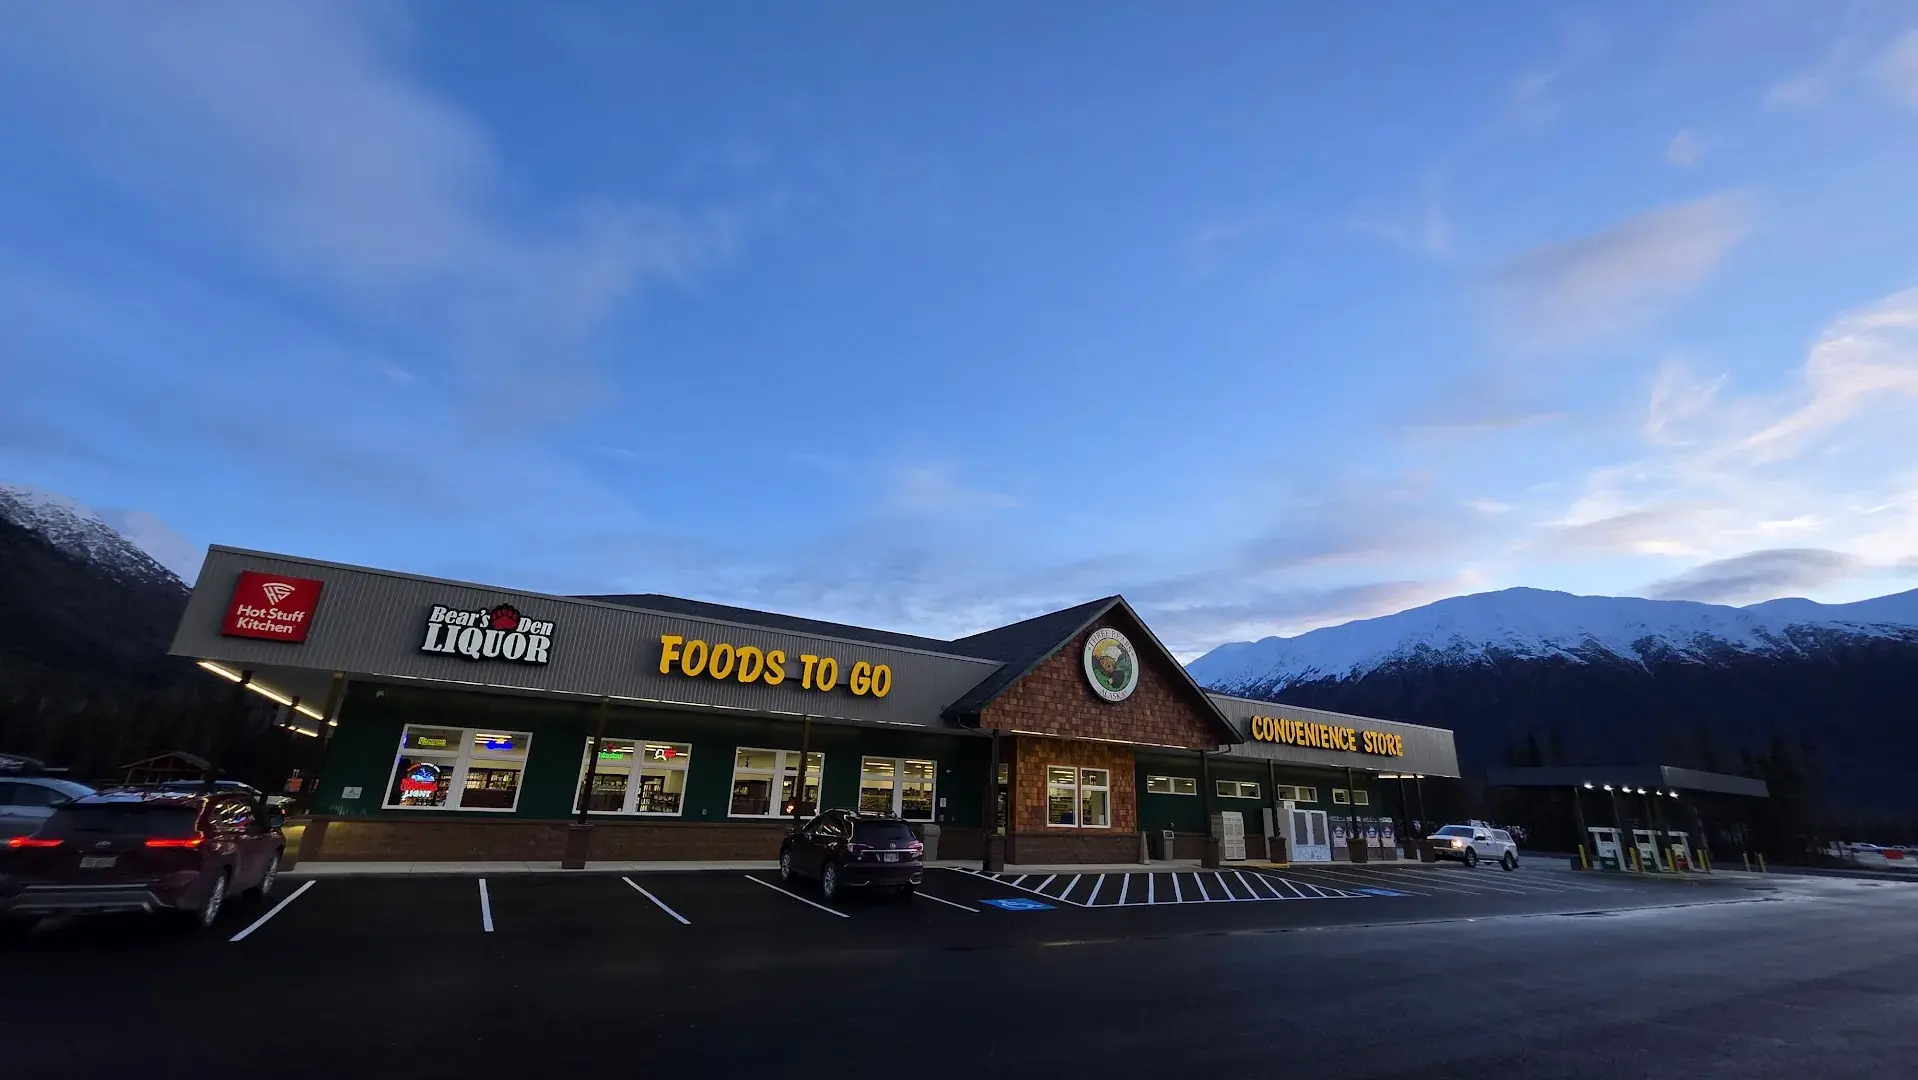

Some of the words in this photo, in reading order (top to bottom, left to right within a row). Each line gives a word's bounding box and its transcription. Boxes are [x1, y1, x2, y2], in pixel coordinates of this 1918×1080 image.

[236, 617, 294, 634] Kitchen
[237, 604, 267, 618] Hot
[267, 608, 305, 623] Stuff
[430, 606, 491, 628] Bear's
[517, 617, 554, 636] Den
[422, 623, 551, 663] LIQUOR
[1088, 630, 1110, 647] THREE
[1111, 630, 1132, 653] BEARS
[659, 635, 786, 686] FOODS
[800, 654, 838, 692] TO
[850, 661, 892, 698] GO
[1100, 689, 1127, 700] ALASKA
[1252, 715, 1357, 752] CONVENIENCE
[1362, 730, 1404, 757] STORE
